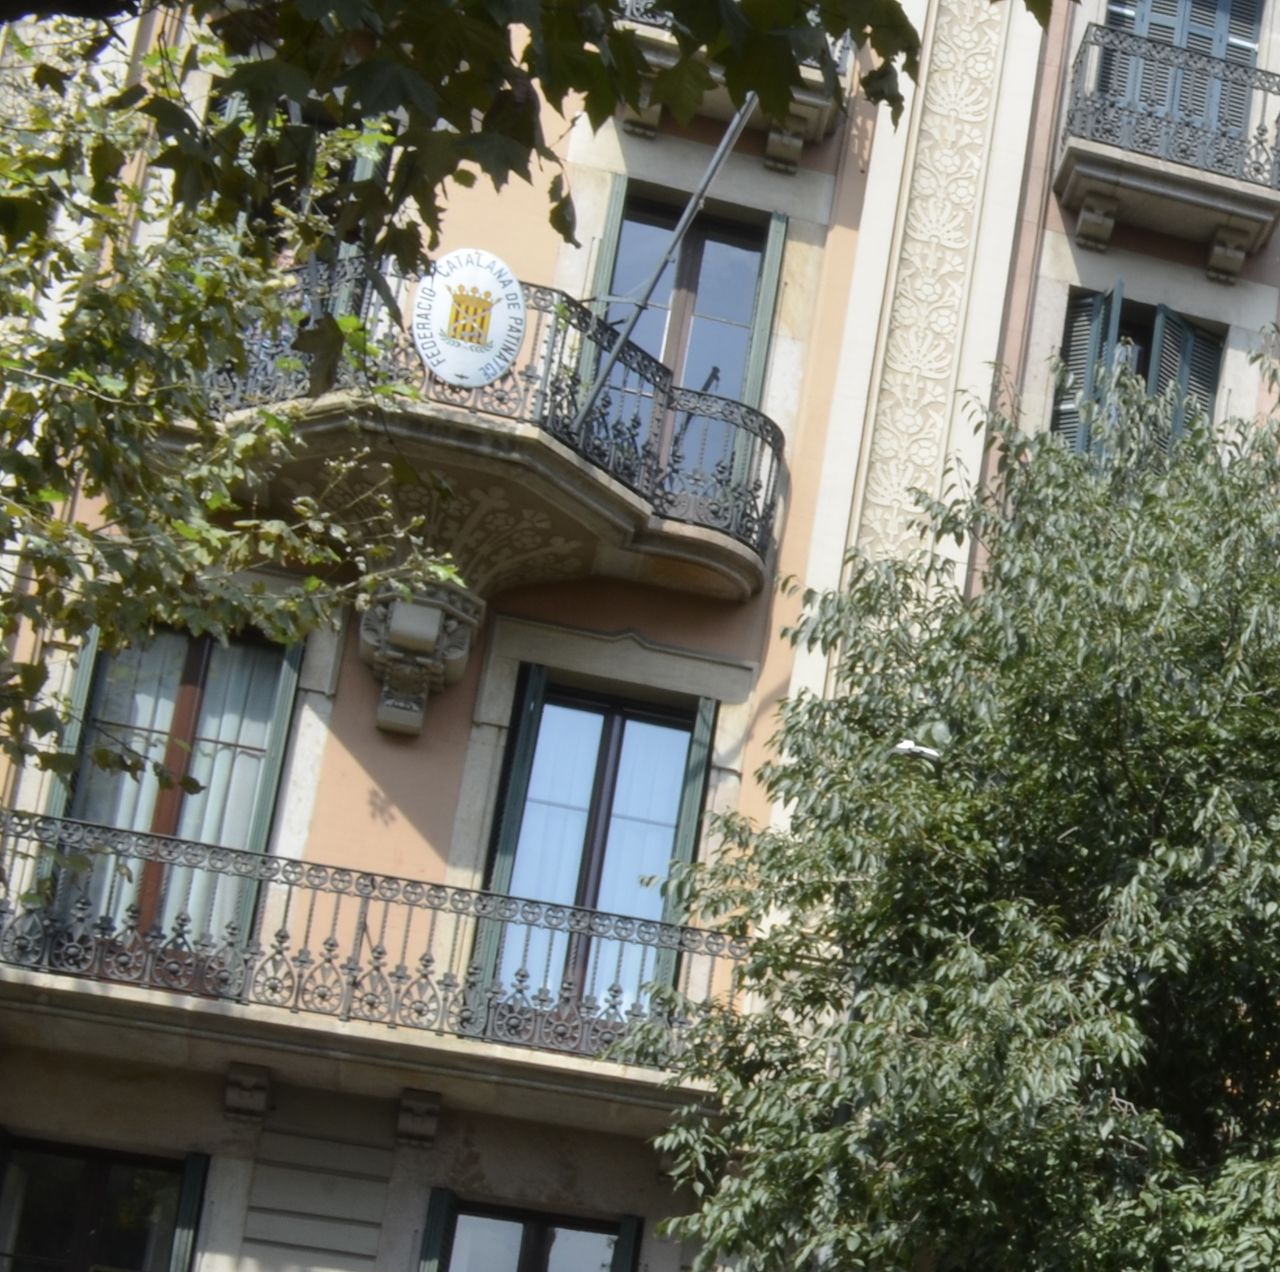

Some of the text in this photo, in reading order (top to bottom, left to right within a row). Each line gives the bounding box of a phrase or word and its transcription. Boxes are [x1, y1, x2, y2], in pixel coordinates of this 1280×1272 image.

[435, 251, 510, 289] CATALANA
[505, 292, 521, 311] DE
[479, 315, 523, 380] PATINATGE
